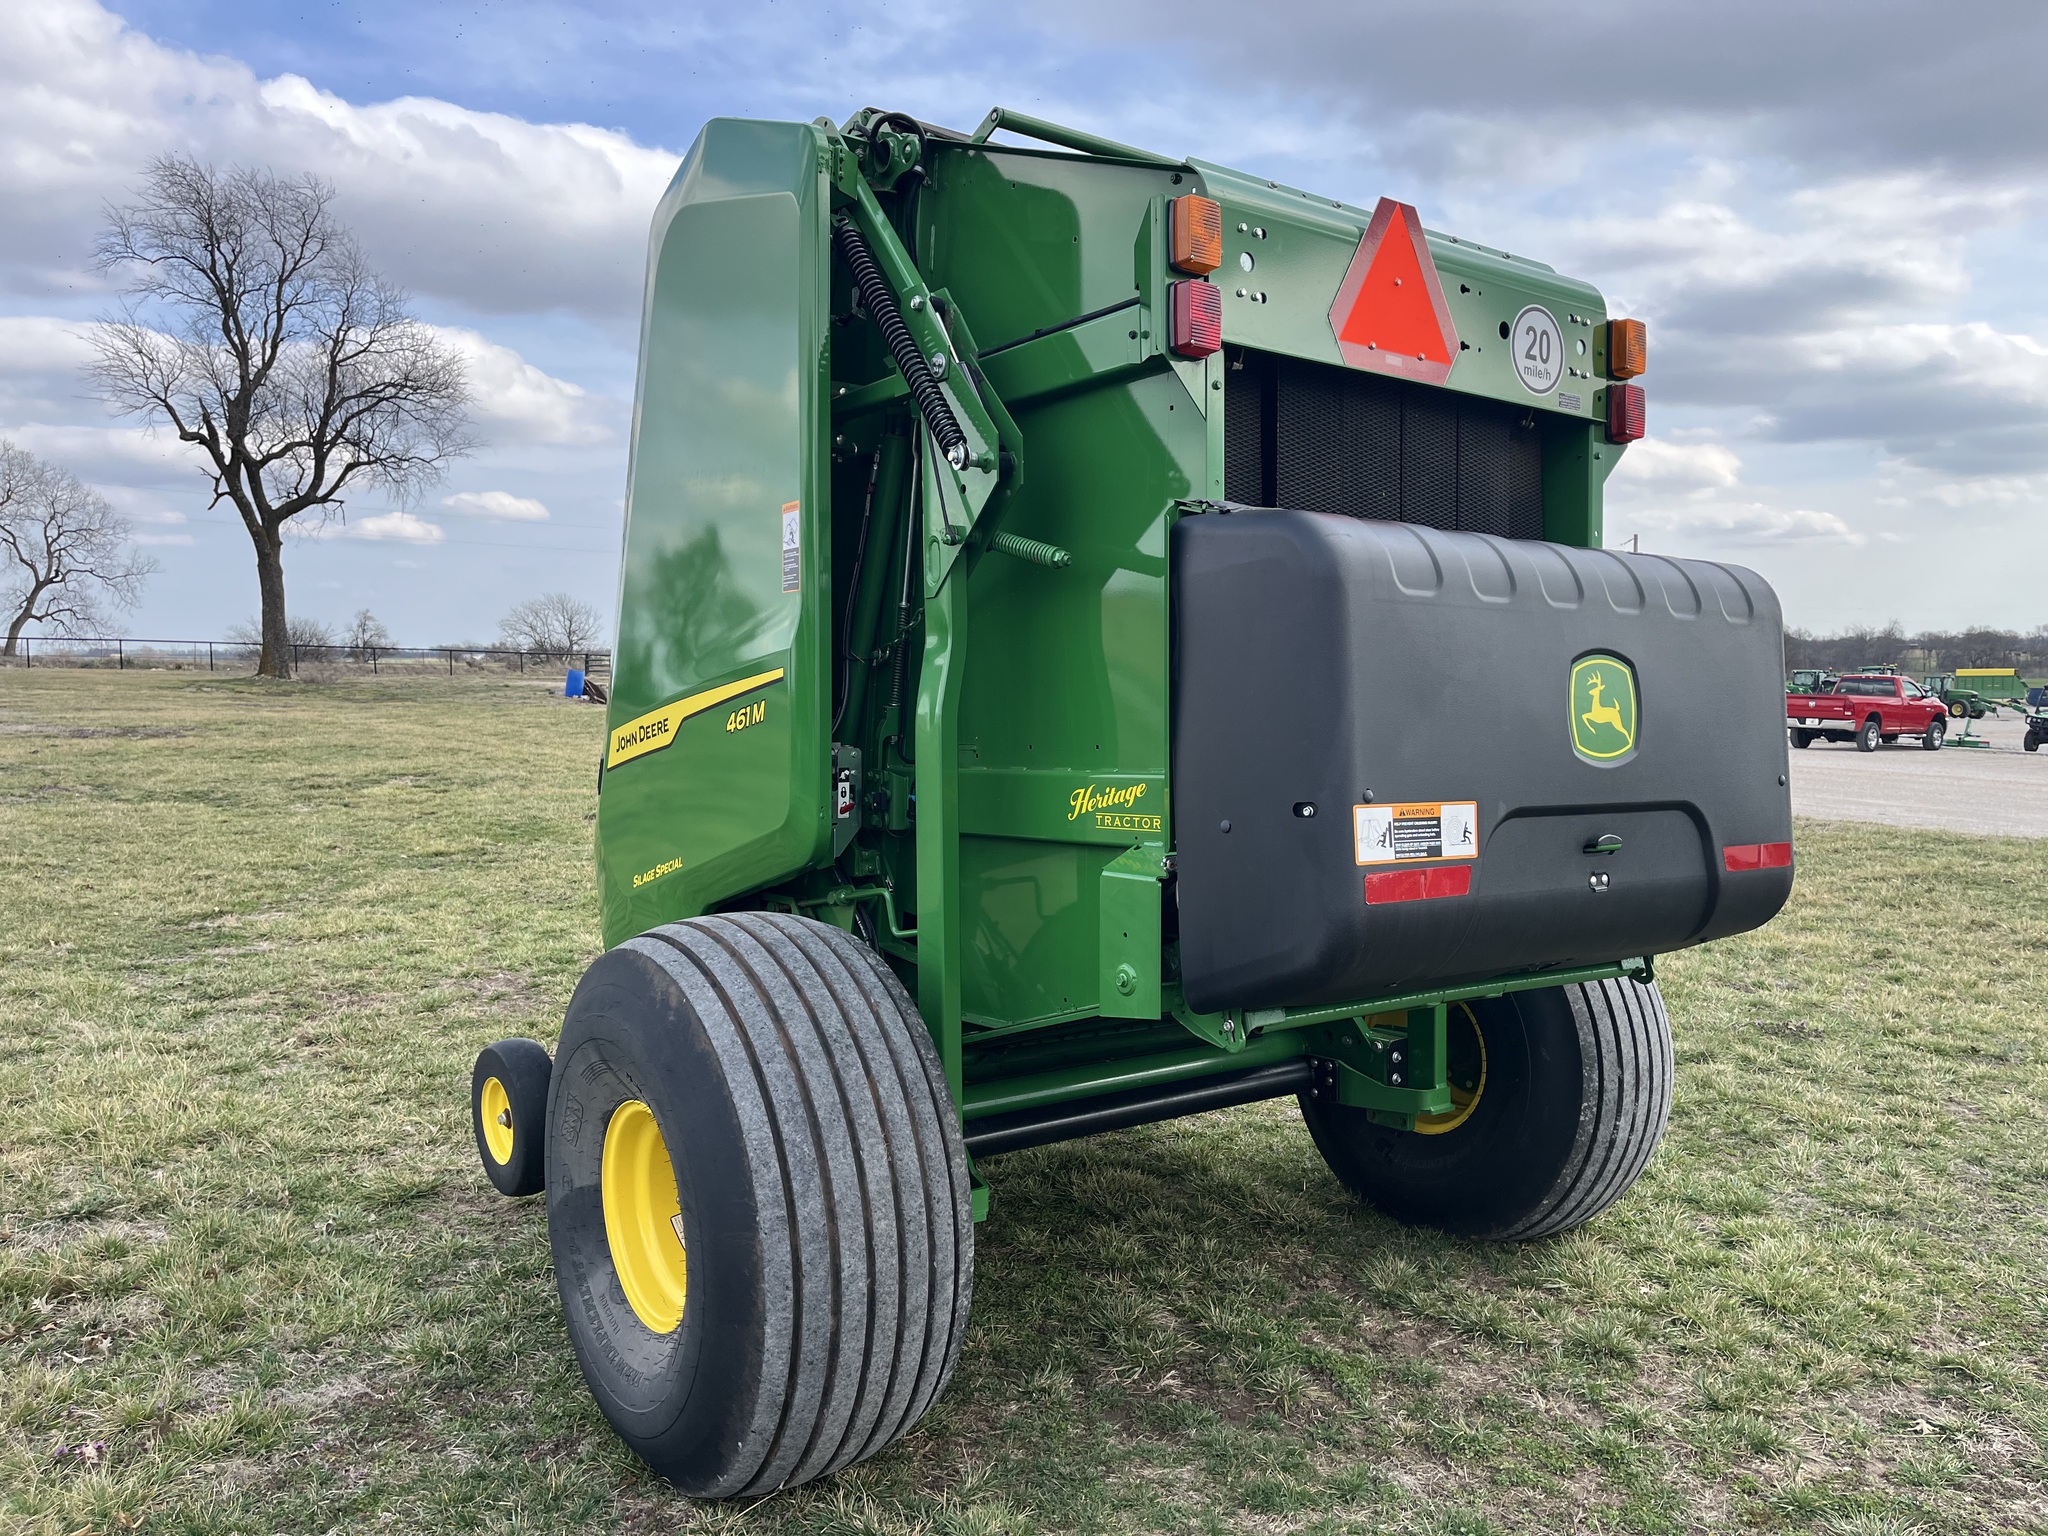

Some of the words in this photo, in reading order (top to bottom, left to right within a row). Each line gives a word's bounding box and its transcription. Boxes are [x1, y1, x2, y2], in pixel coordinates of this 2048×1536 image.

[1525, 325, 1551, 365] 20
[1523, 365, 1551, 381] mile/h
[616, 732, 638, 752] JOHN
[638, 718, 669, 743] DEERE
[1067, 783, 1148, 821] Heritage
[1406, 808, 1435, 816] WARNING
[1095, 815, 1161, 829] TRACTOR
[633, 868, 655, 888] SILAGE
[655, 856, 683, 878] SPECIAL
